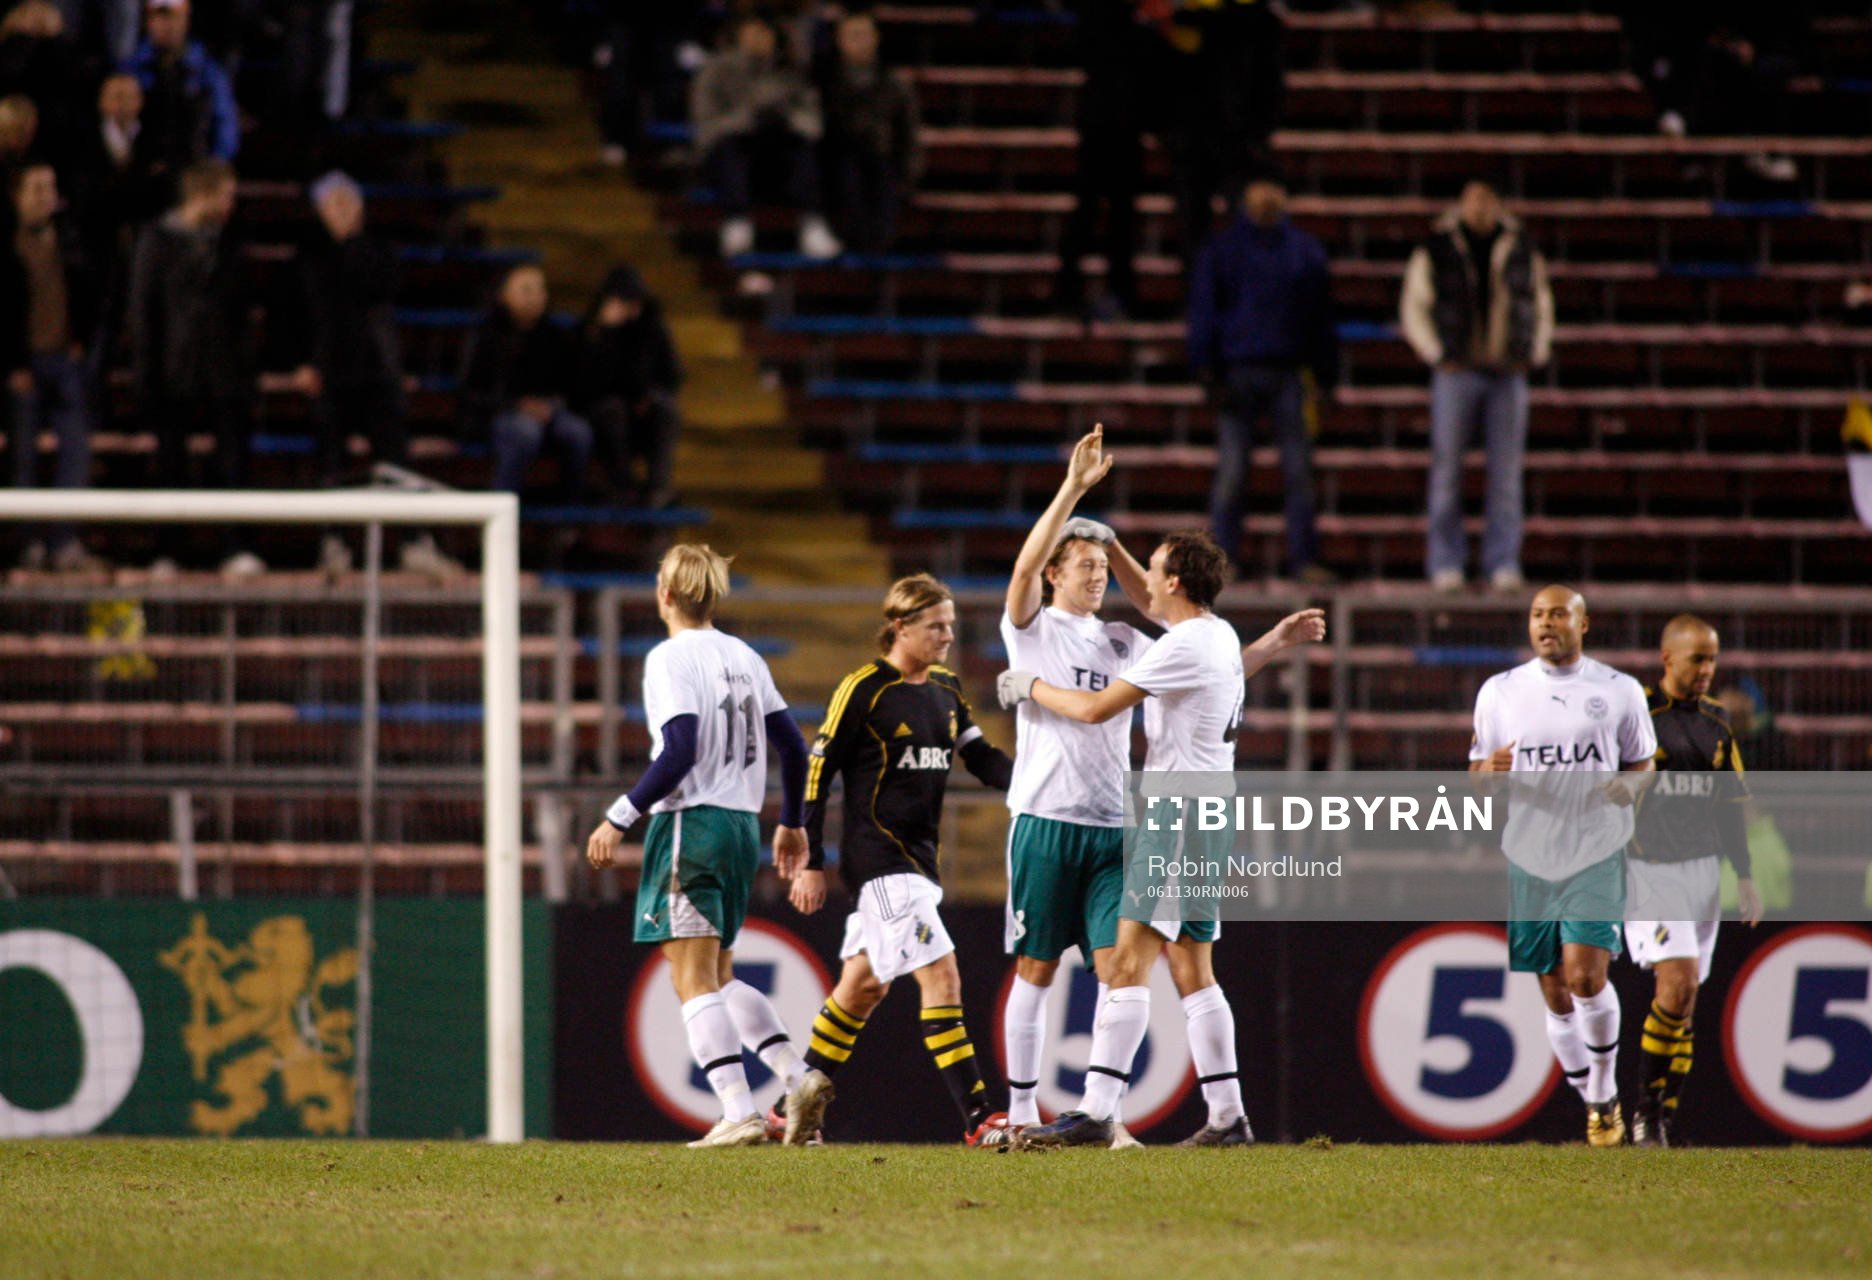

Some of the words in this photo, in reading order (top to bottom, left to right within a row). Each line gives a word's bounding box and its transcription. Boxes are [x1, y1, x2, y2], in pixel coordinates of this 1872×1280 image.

[718, 693, 757, 770] 11
[1519, 742, 1604, 767] TELIA
[1418, 966, 1515, 1100] 5
[1782, 966, 1872, 1101] 5
